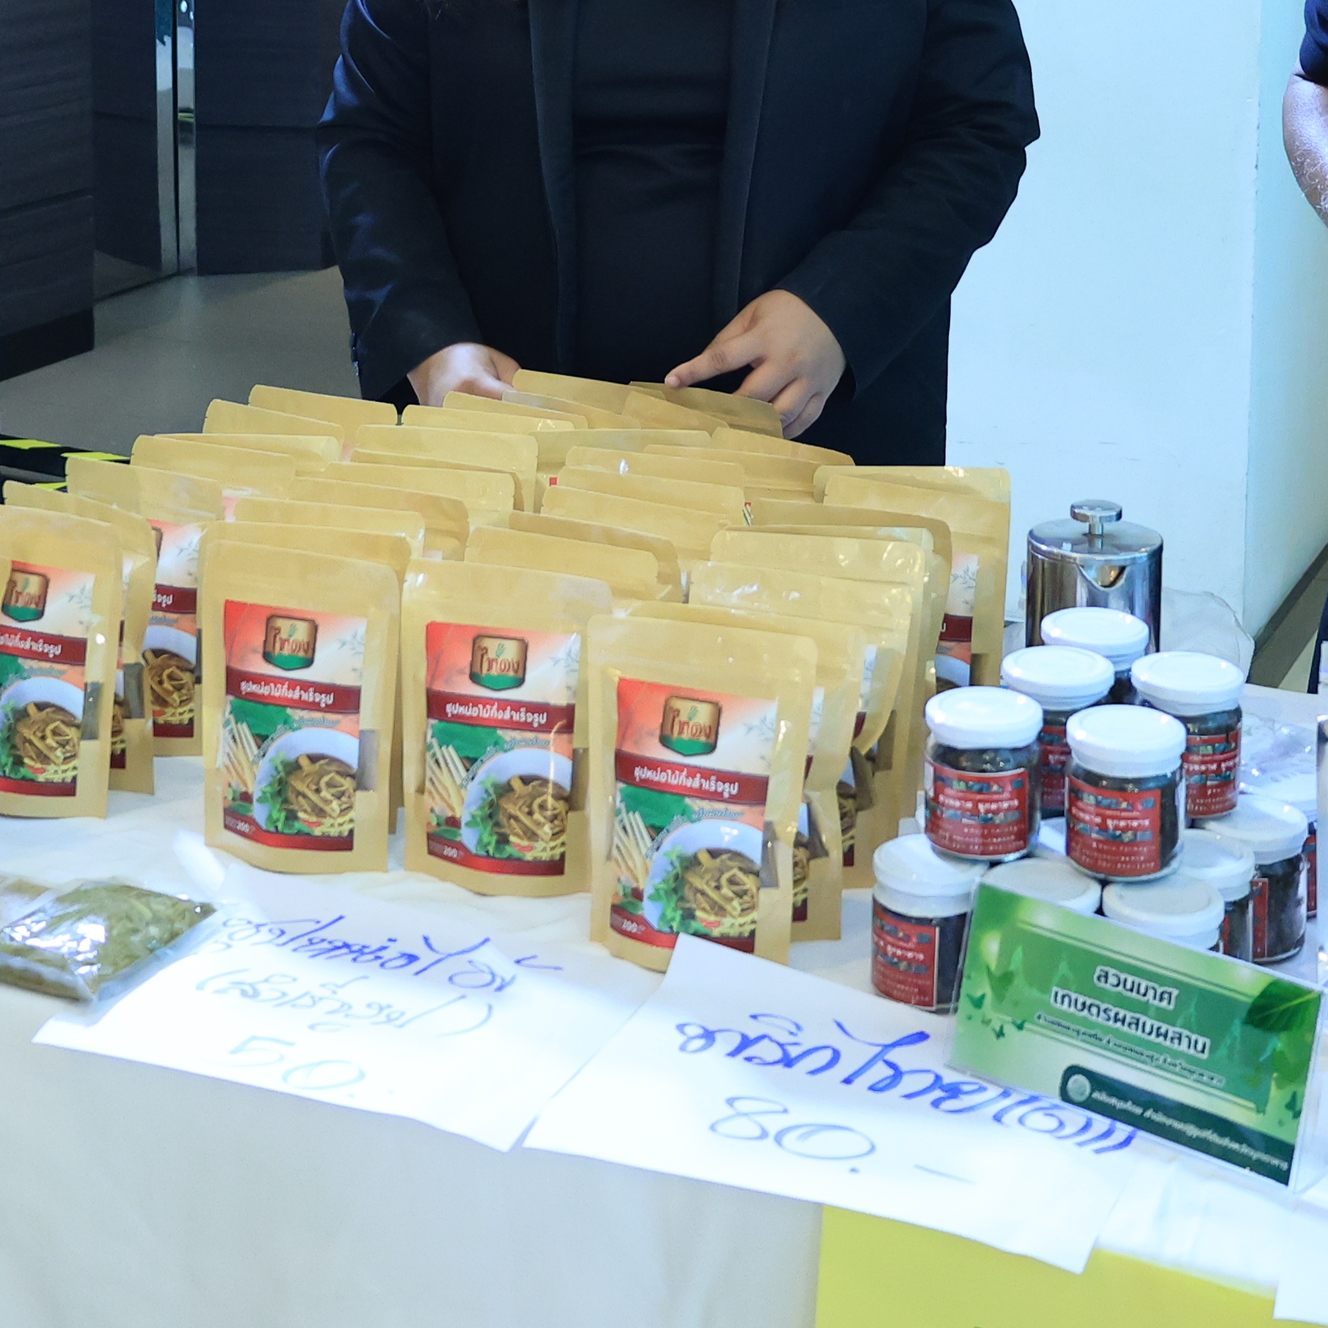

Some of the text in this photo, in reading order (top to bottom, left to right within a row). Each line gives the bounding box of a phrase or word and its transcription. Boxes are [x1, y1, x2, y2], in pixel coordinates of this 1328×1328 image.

[1095, 967, 1175, 1008] สวนมาศ
[1053, 989, 1209, 1056] เกษตรผสมผสาน
